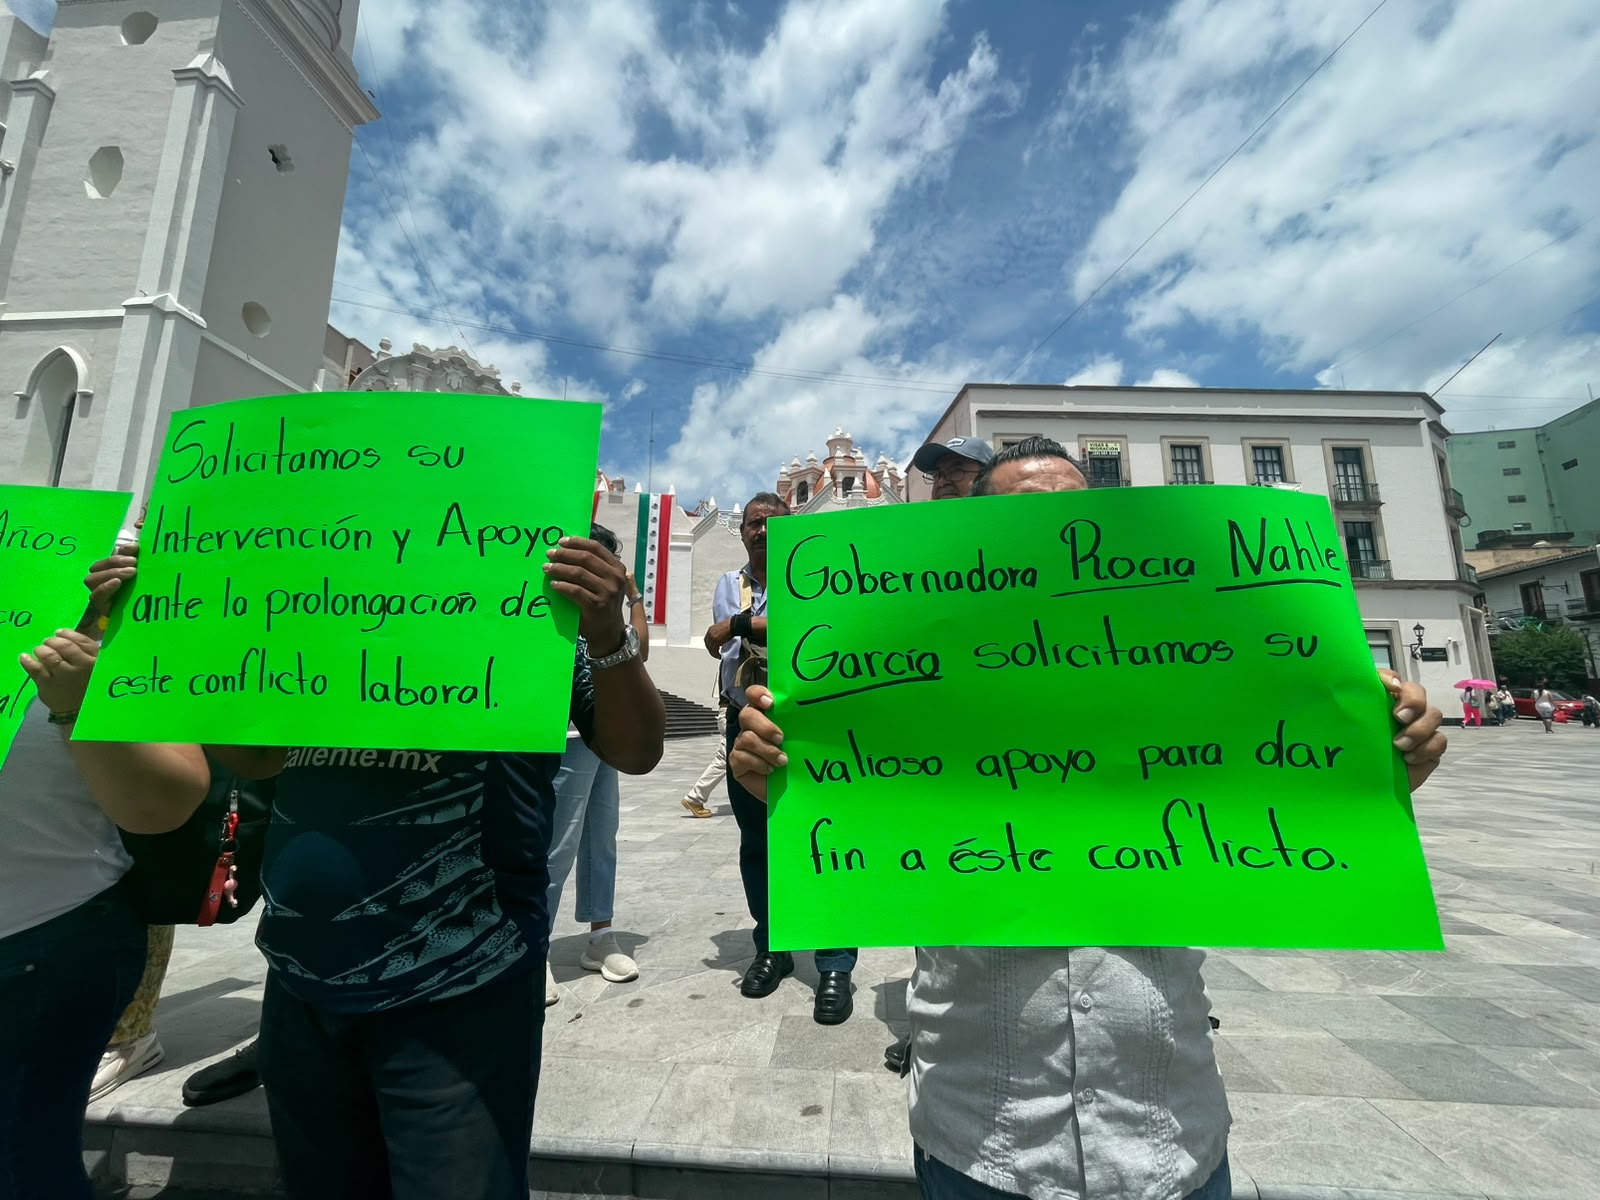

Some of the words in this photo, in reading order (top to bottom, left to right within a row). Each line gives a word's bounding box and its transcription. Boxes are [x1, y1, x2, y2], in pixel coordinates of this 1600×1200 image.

[168, 417, 380, 484] Solicitamos
[408, 444, 465, 469] su
[152, 505, 372, 554] Intervención
[392, 529, 411, 565] y
[436, 501, 565, 558] Apoyo
[785, 534, 1038, 601] Gobernadora
[1226, 516, 1341, 577] Nahle
[132, 572, 204, 624] ante
[224, 576, 248, 619] la
[499, 580, 551, 619] de
[107, 655, 174, 699] este
[188, 647, 328, 697] conflicto
[360, 648, 499, 710] laboral.
[791, 623, 941, 682] García
[974, 614, 1235, 670] solicitamos
[1264, 632, 1319, 658] su
[803, 728, 943, 784] valioso
[975, 748, 1096, 791] apoyo
[1138, 743, 1222, 781] para
[1256, 719, 1344, 770] dar
[809, 817, 866, 875] fin
[899, 848, 927, 871] a
[947, 821, 1054, 874] éste
[1087, 798, 1349, 872] conflicto.
